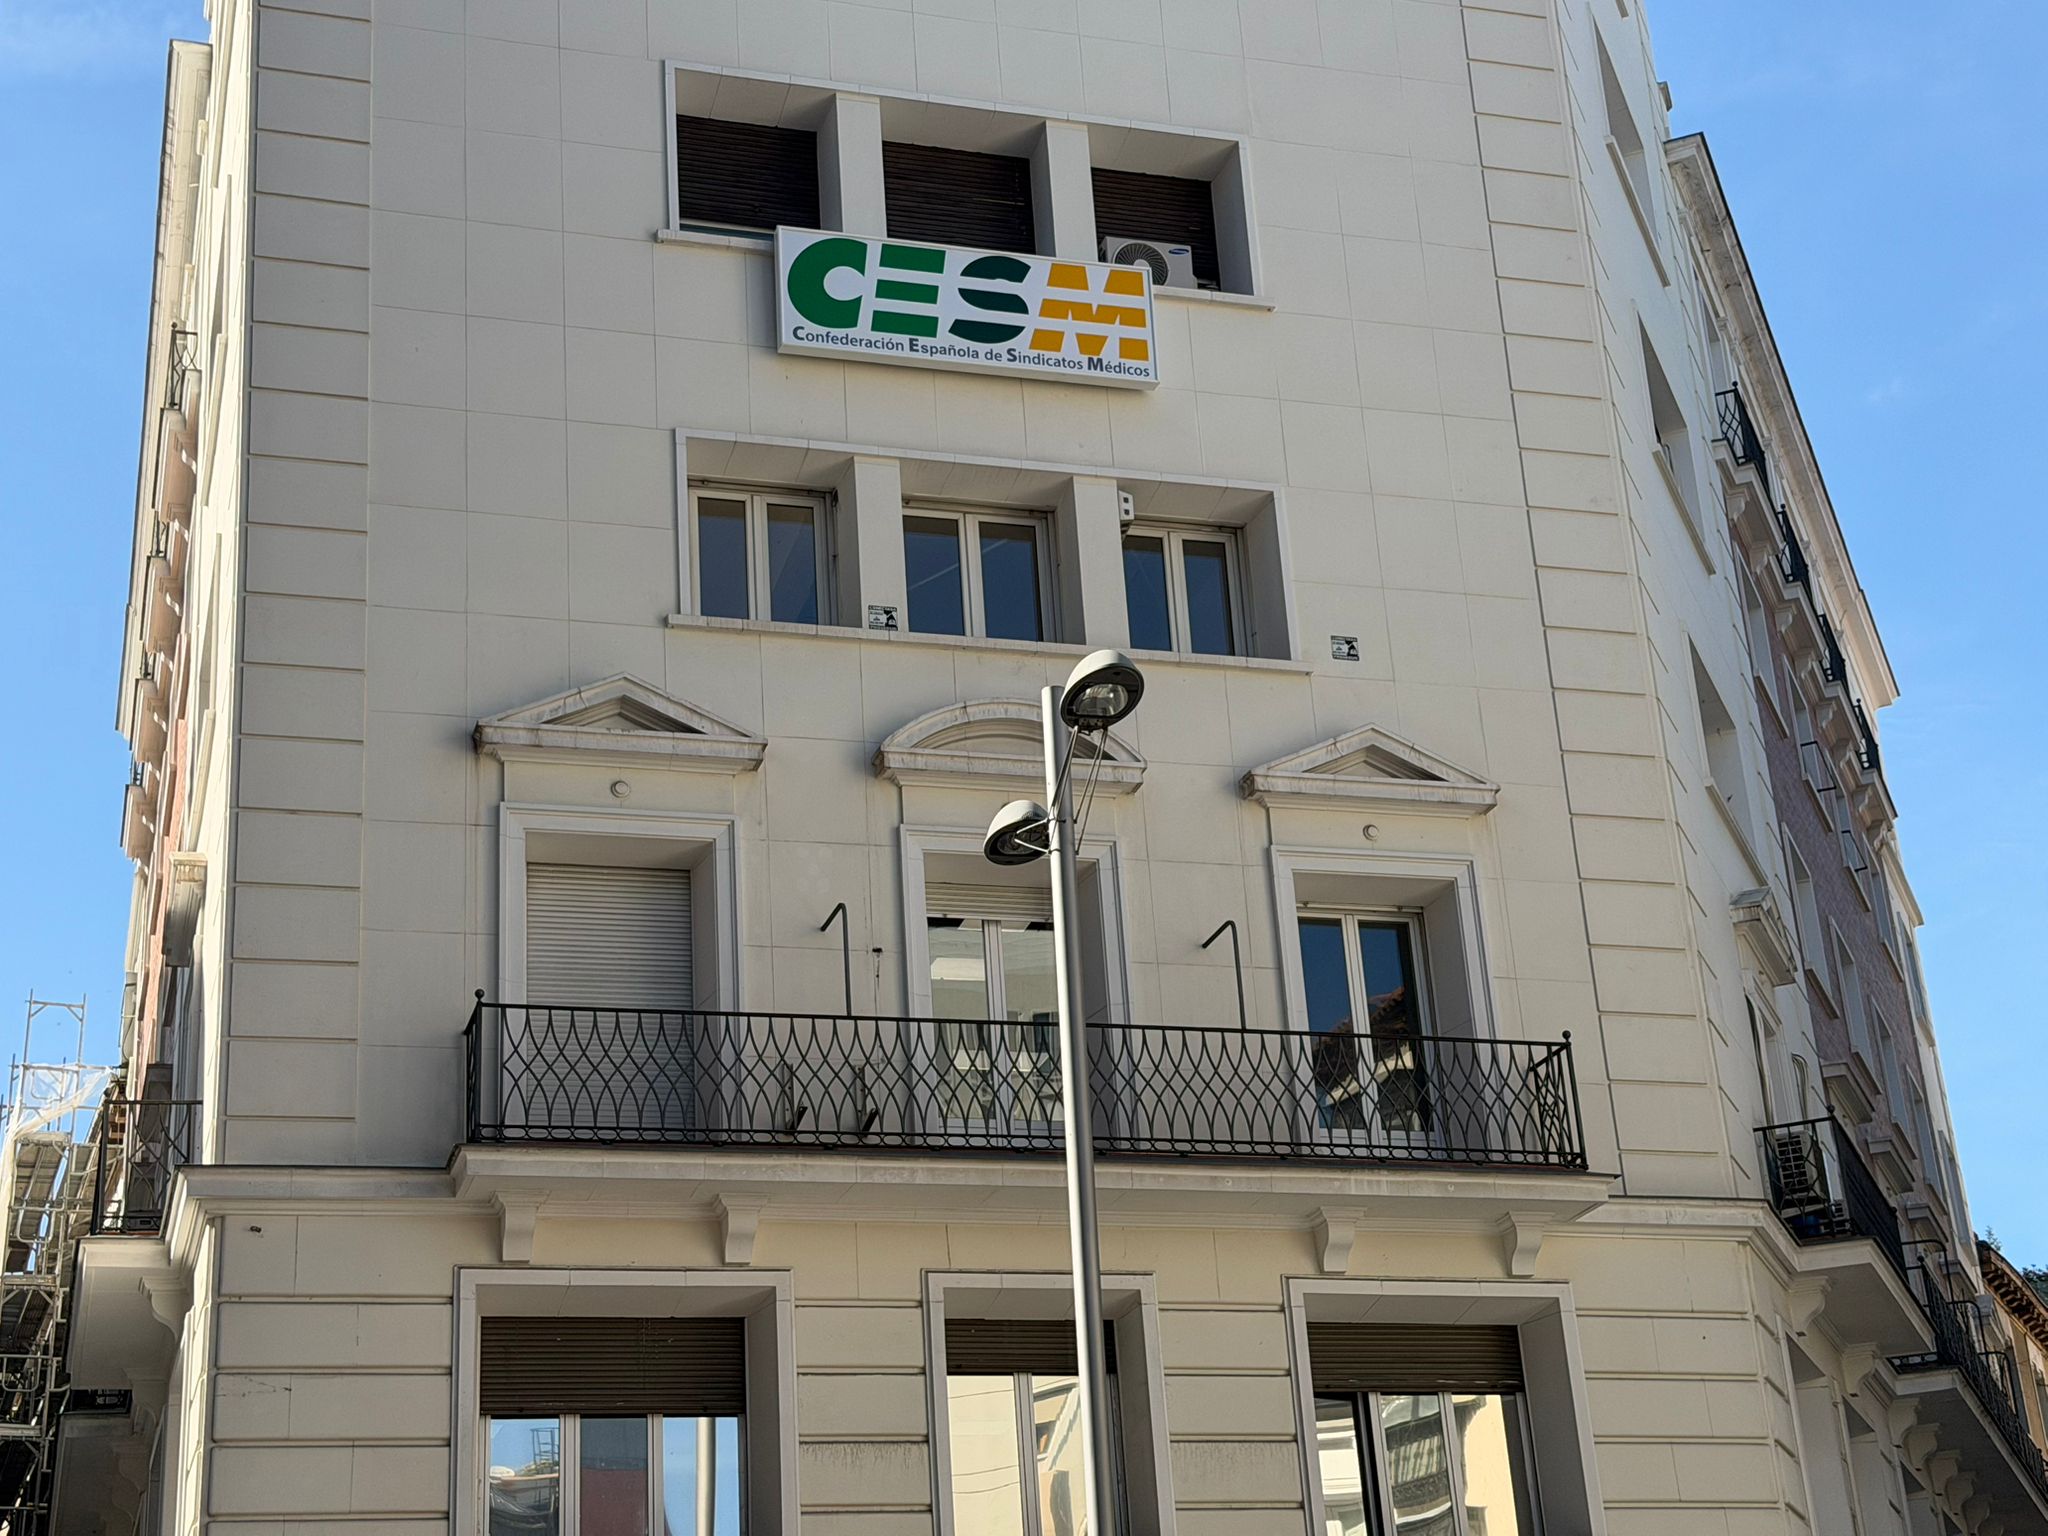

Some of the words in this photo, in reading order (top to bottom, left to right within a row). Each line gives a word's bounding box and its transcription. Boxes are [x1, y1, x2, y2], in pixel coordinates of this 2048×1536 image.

[787, 237, 1150, 362] CESM
[792, 326, 905, 351] Confederación
[908, 337, 979, 358] Española
[984, 348, 1003, 362] de
[1006, 347, 1083, 370] Sindicatos
[1087, 356, 1150, 377] Médicos
